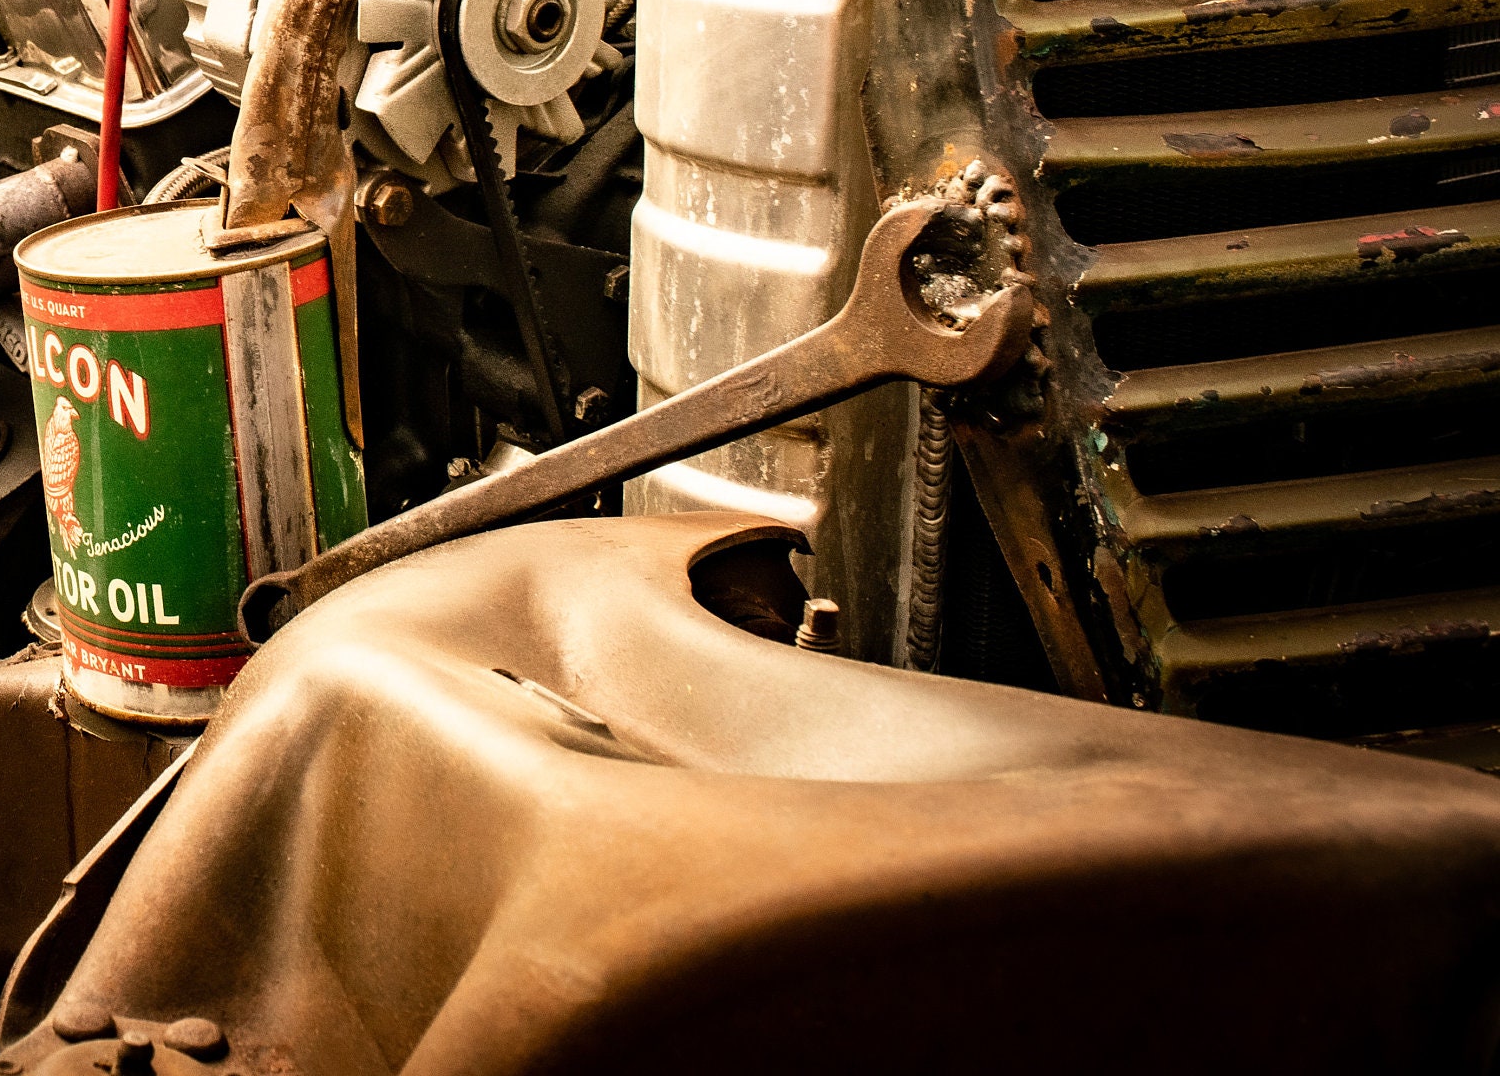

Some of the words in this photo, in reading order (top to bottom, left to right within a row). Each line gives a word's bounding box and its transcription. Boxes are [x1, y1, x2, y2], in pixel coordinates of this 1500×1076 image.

[31, 296, 47, 312] U.S.
[47, 300, 86, 319] QUART
[26, 324, 150, 439] LCON
[81, 504, 165, 558] Tenacious
[52, 552, 101, 616] TOR
[107, 578, 180, 625] OIL
[80, 648, 147, 681] BRYANT
